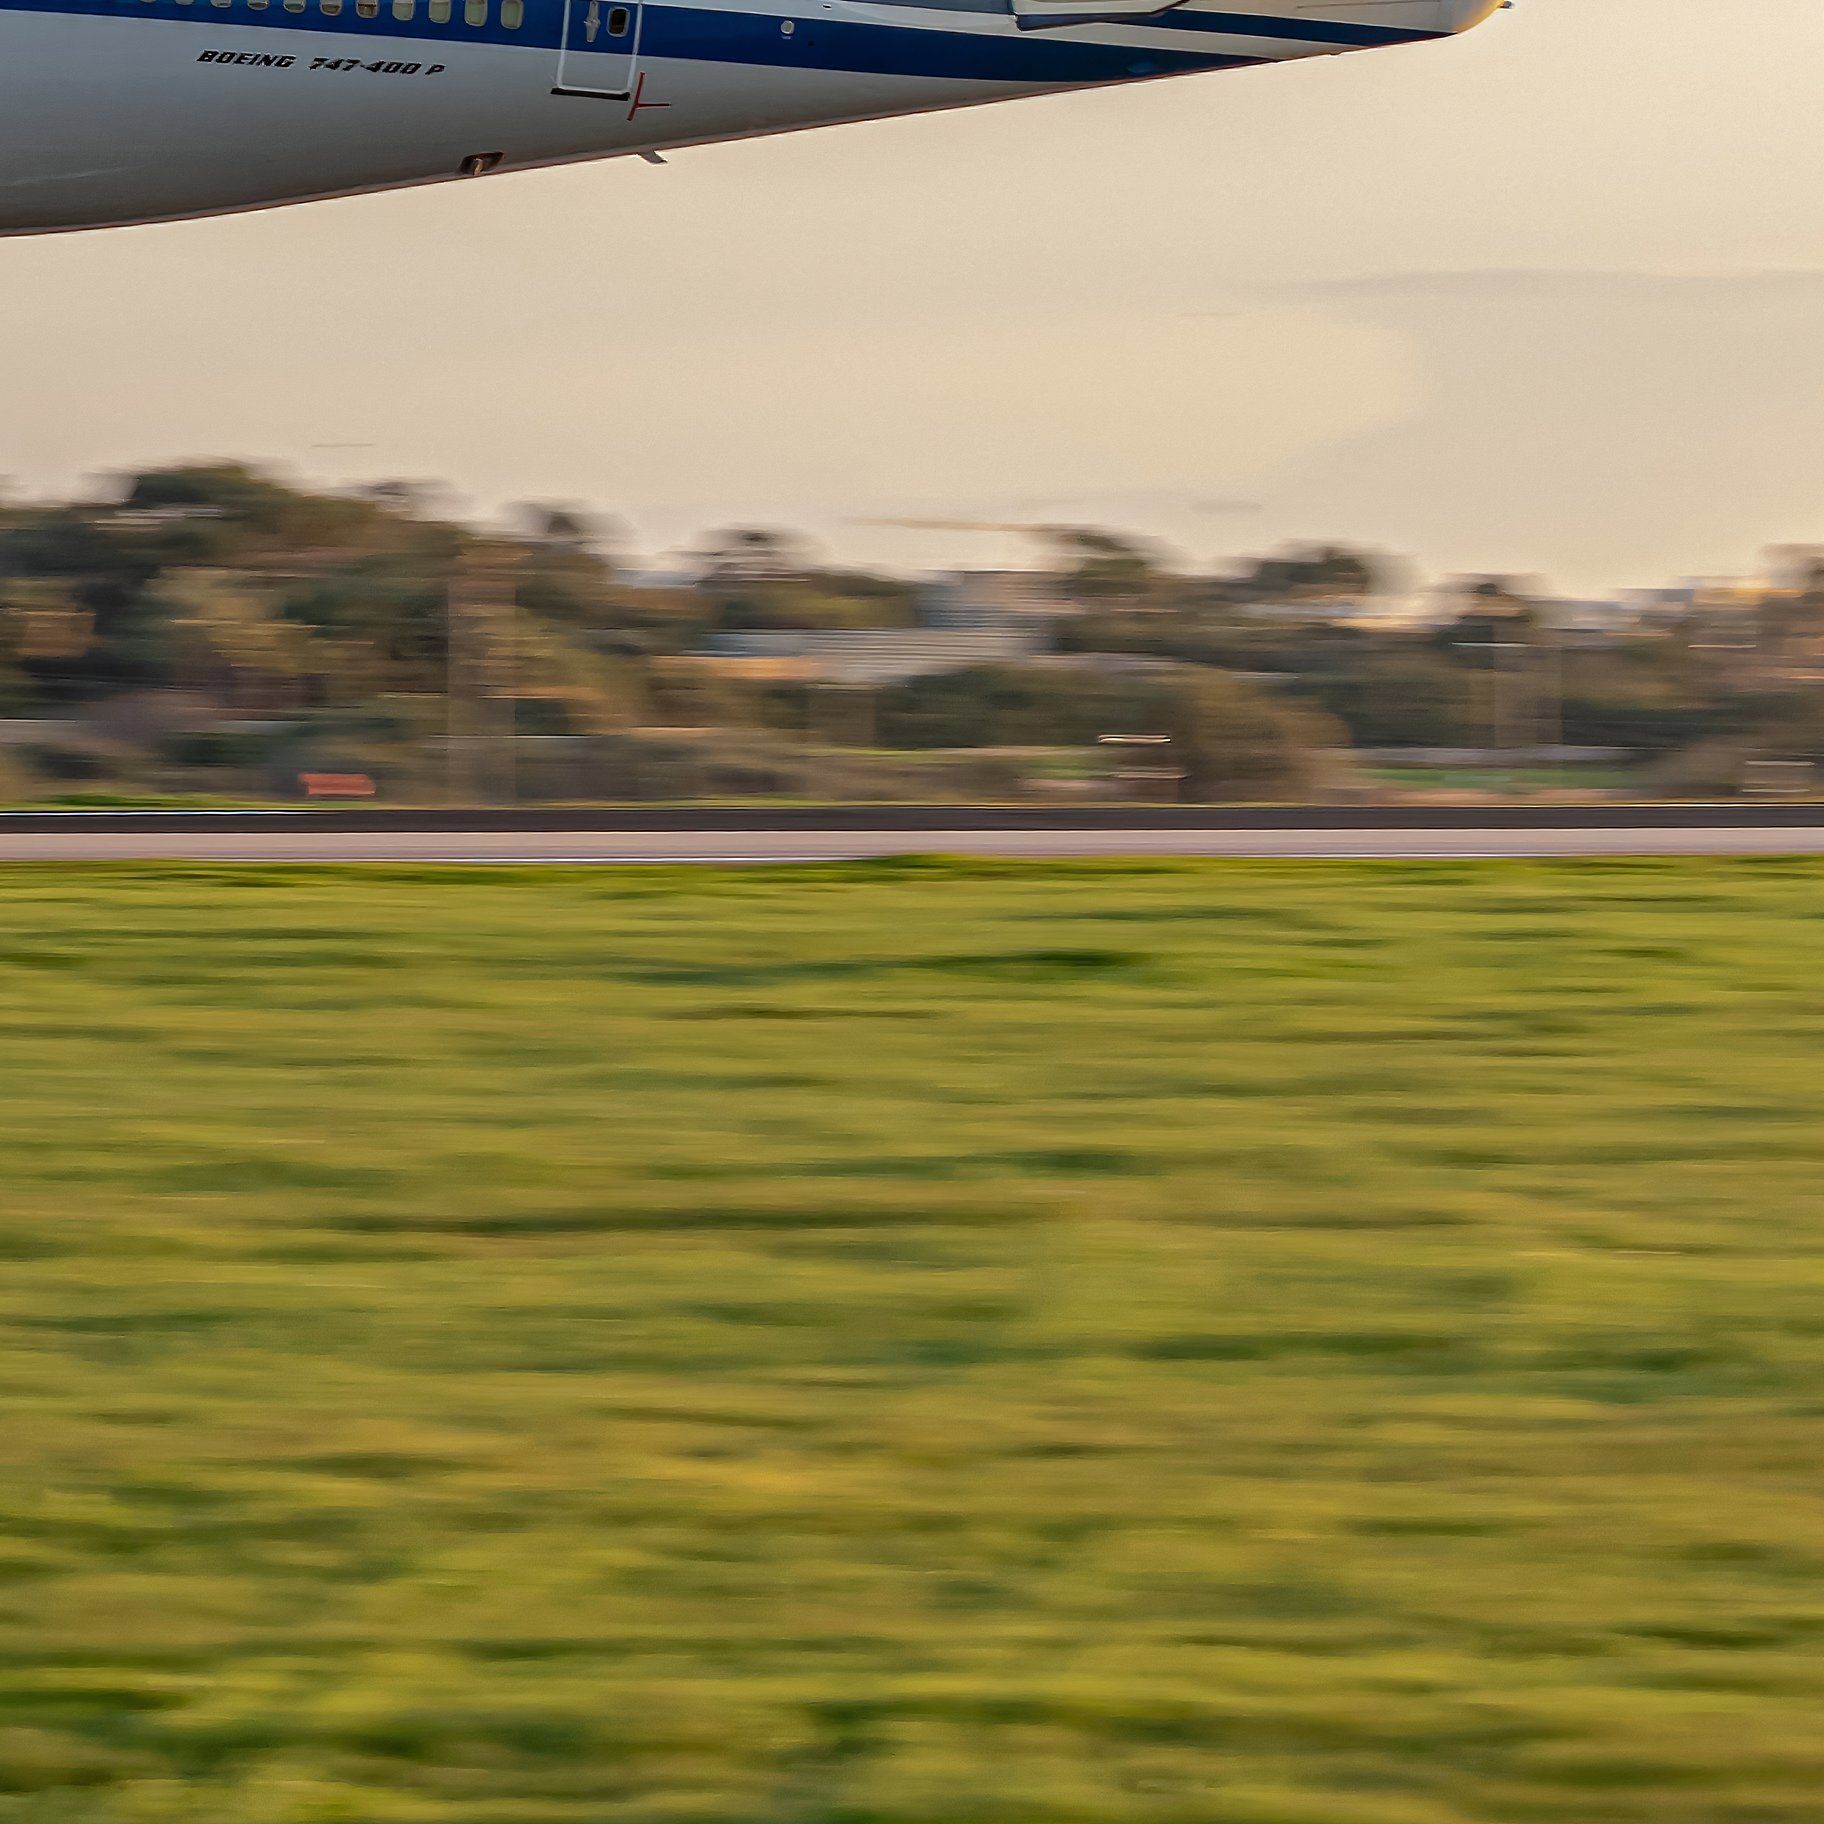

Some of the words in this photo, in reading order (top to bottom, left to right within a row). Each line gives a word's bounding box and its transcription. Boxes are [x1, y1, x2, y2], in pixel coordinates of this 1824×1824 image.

[196, 50, 297, 68] BOEING
[308, 57, 422, 75] 747-400
[424, 64, 446, 76] P
